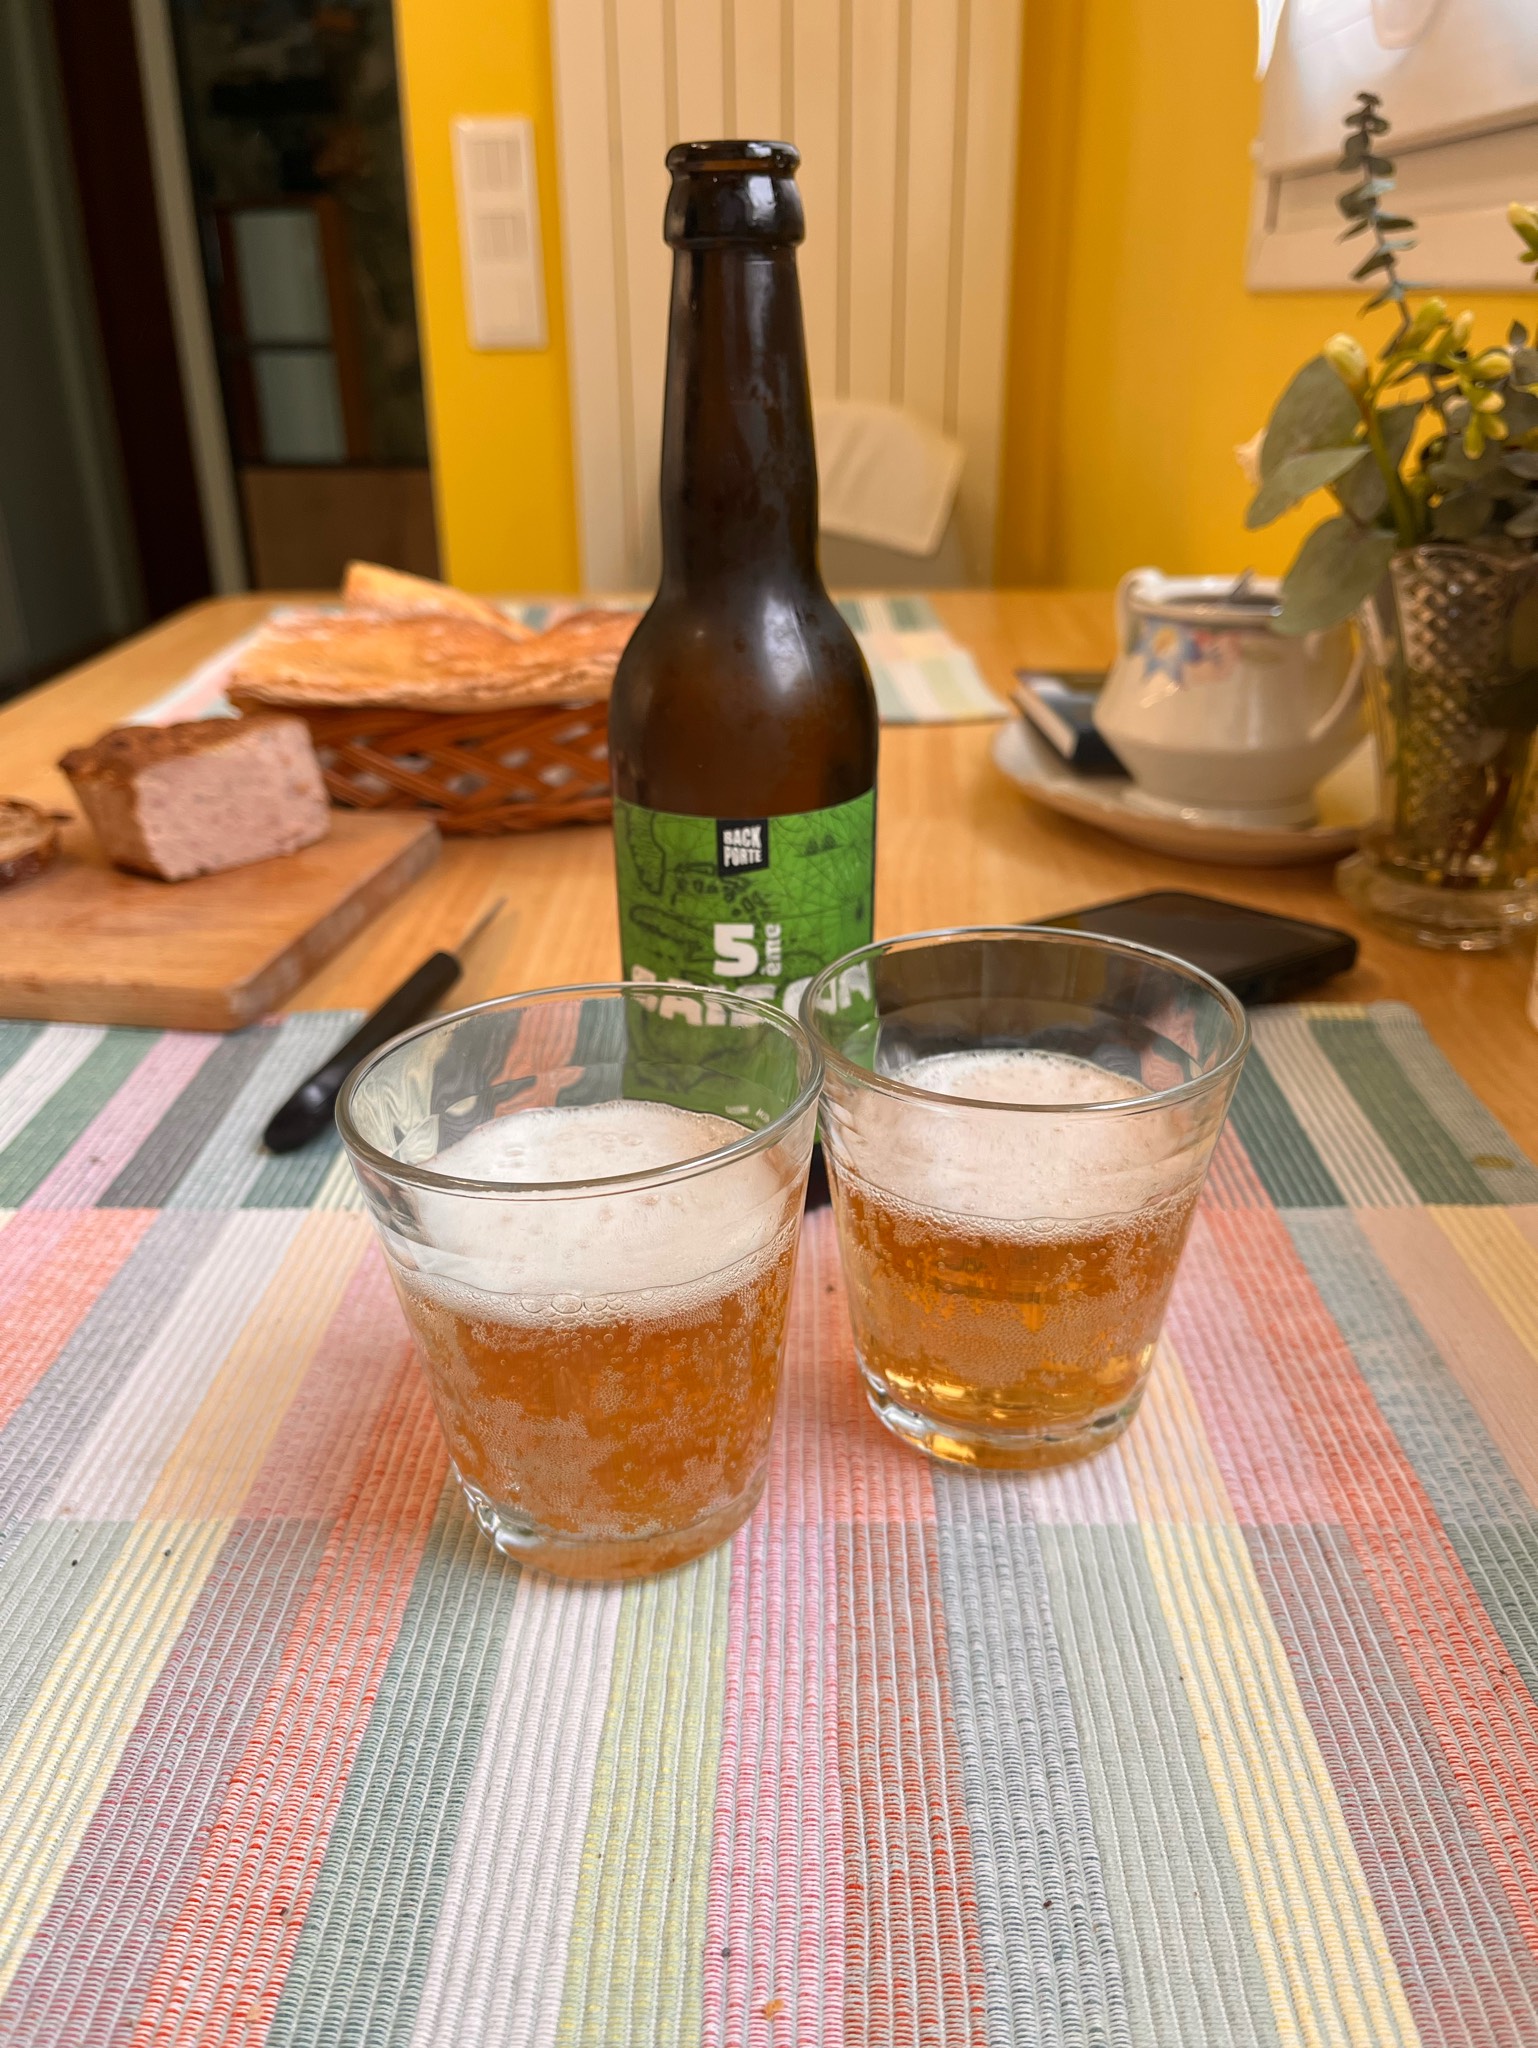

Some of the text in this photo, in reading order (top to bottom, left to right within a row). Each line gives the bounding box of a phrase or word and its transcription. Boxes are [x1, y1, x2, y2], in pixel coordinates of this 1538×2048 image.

[722, 825, 762, 849] BACK
[722, 846, 762, 867] PORTE
[713, 924, 759, 977] 5
